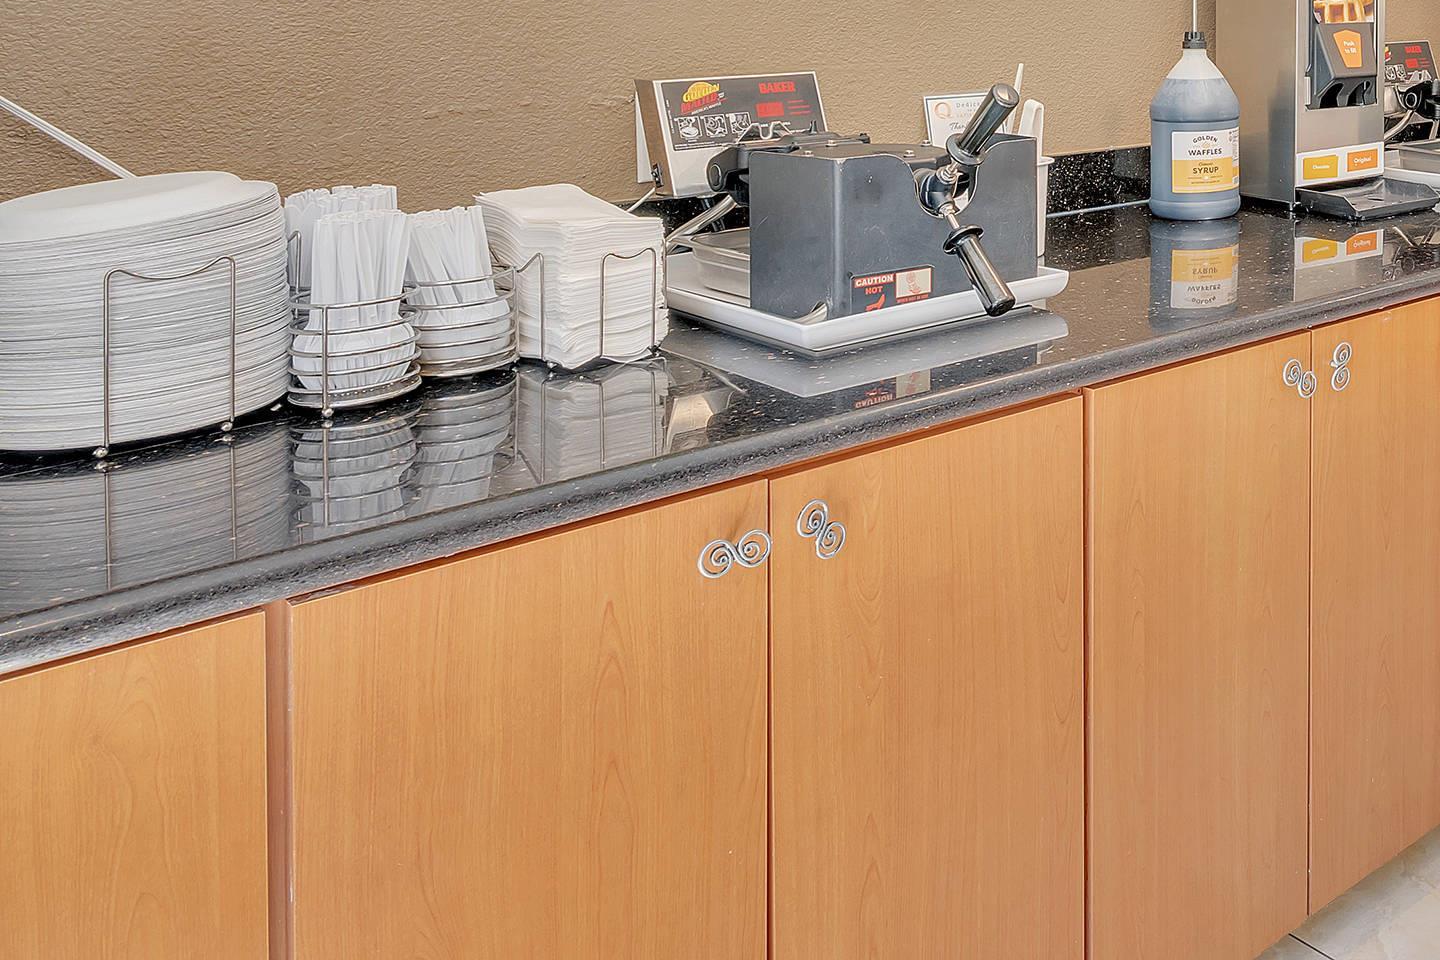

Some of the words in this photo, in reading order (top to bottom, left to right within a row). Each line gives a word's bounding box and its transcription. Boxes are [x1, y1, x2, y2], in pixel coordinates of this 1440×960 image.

[758, 81, 796, 94] BAKER
[1192, 135, 1218, 144] GOLDEN
[1188, 148, 1223, 156] WAFFLES
[1192, 166, 1219, 175] SYRUP
[855, 274, 894, 287] CAUTION
[865, 286, 883, 295] HOT
